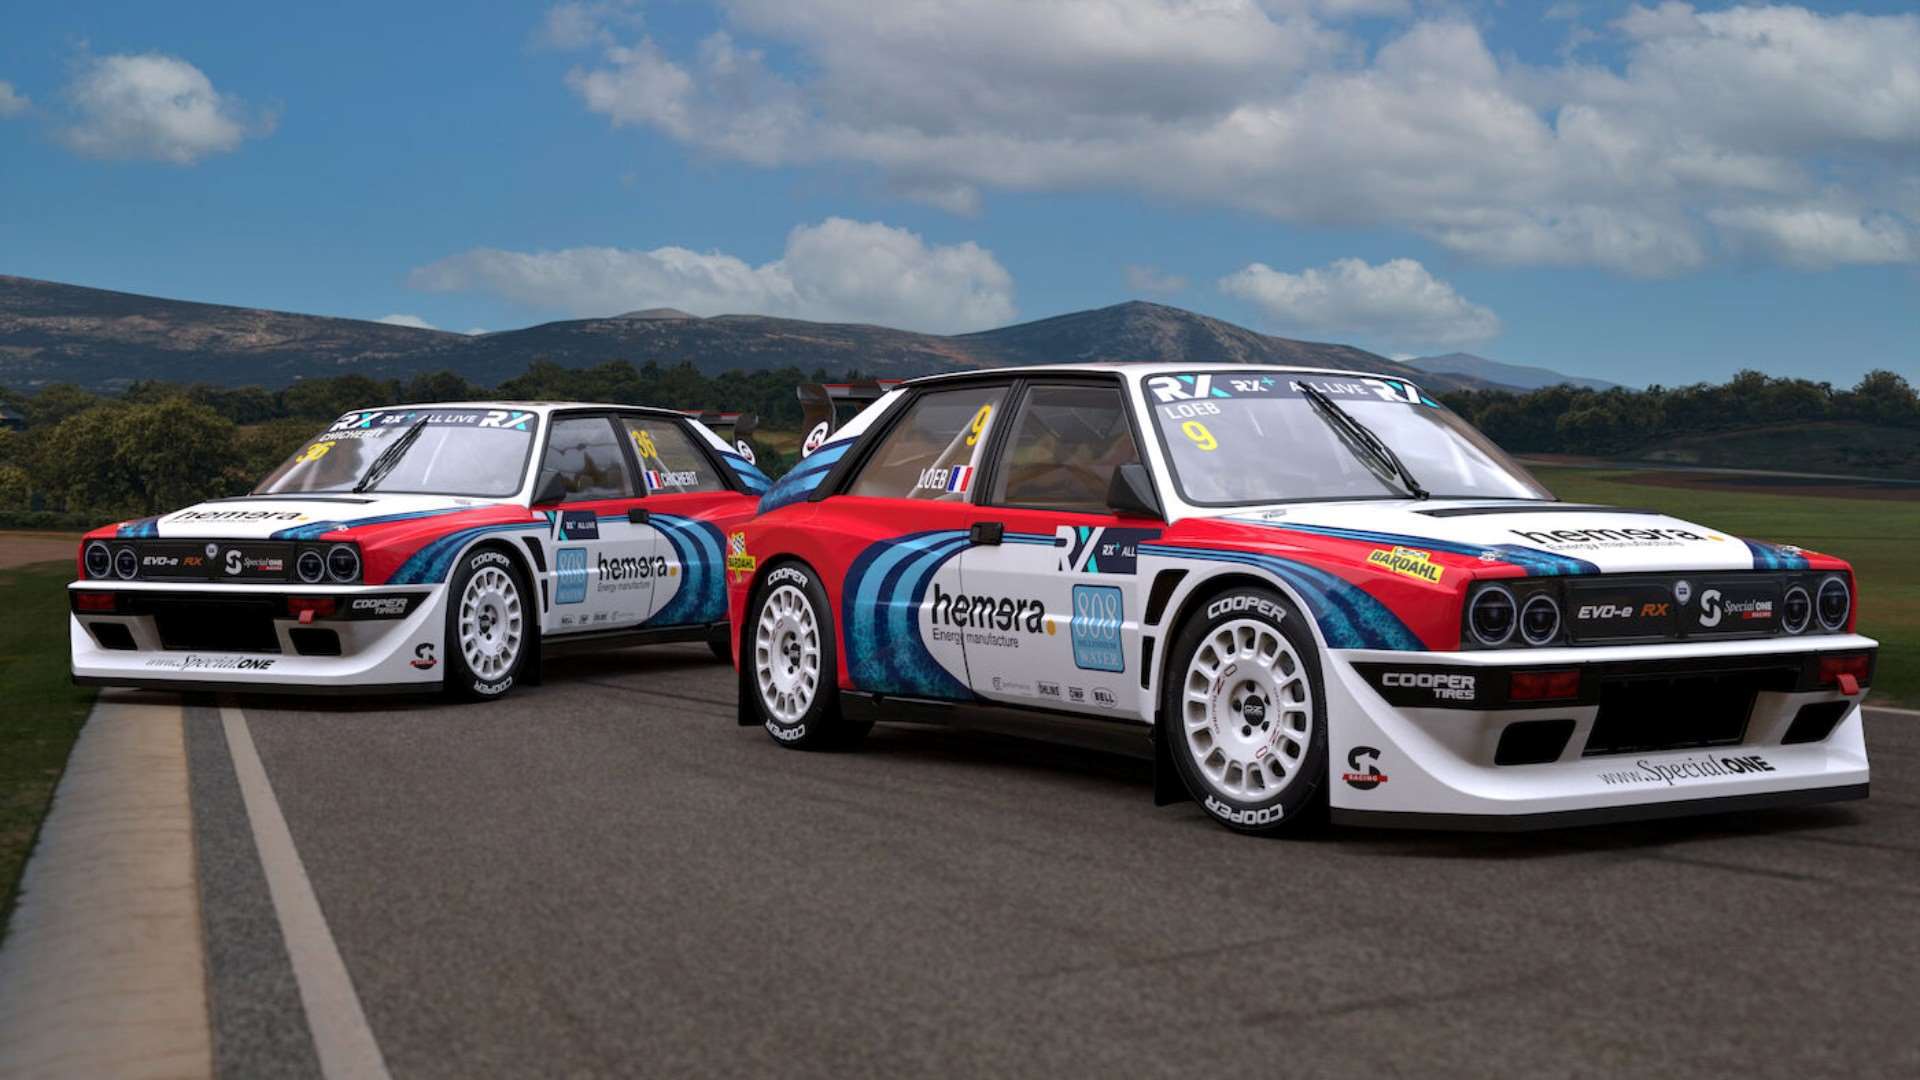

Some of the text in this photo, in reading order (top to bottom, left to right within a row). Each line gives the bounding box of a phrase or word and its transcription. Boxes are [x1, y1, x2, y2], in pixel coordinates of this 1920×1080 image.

[1148, 374, 1233, 402] RX
[1325, 382, 1369, 395] LIVE
[1360, 378, 1440, 409] RX
[330, 411, 384, 432] RX
[442, 414, 478, 424] LIVE
[478, 411, 534, 431] RX
[1164, 401, 1221, 420] LOEB
[965, 404, 992, 447] 9
[1181, 420, 1218, 452] 9
[630, 430, 658, 459] 36
[917, 467, 949, 490] LOEB
[1055, 525, 1106, 574] RX
[1121, 546, 1136, 557] ALL
[143, 556, 204, 567] EVO-e RX
[471, 552, 511, 570] COOPER
[1371, 550, 1438, 582] BARDAHL
[767, 567, 809, 589] COOPER
[352, 598, 409, 610] COOPER
[1207, 596, 1287, 624] COOPER
[1577, 603, 1668, 620] EVO-e RX
[1075, 591, 1117, 641] 808
[966, 632, 1020, 649] manufacture
[1382, 672, 1476, 690] COOPER
[1094, 690, 1114, 704] BELL
[1433, 688, 1476, 700] TIRES
[766, 719, 807, 741] COOPER
[1204, 795, 1285, 825] COOPER
